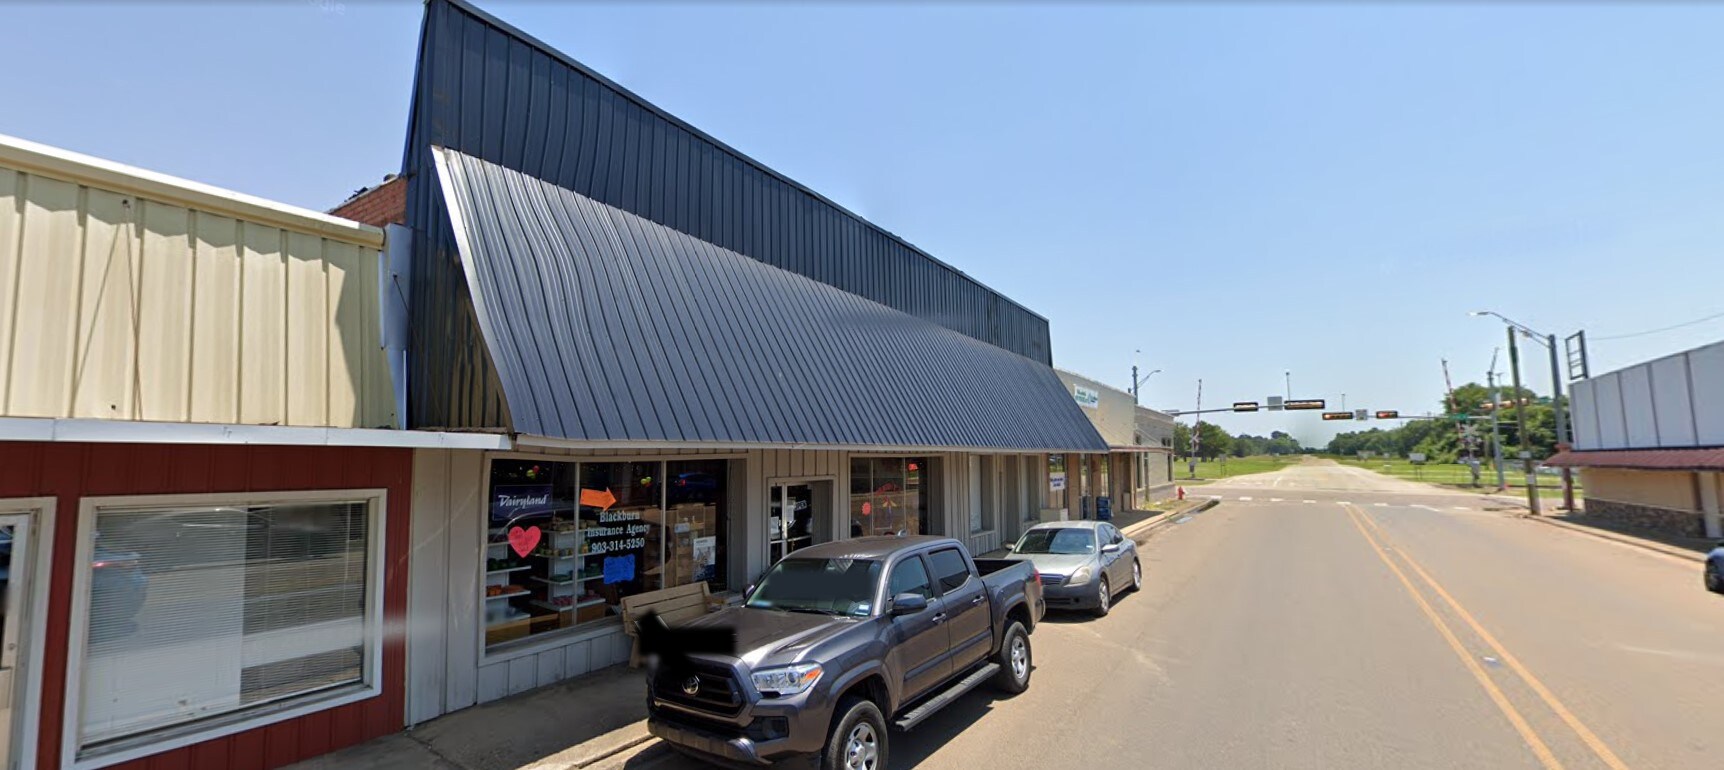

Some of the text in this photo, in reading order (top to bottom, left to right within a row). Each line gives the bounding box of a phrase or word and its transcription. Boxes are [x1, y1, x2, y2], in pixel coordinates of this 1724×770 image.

[498, 494, 549, 509] Dairyland
[600, 511, 640, 523] Blackburn
[587, 524, 650, 537] Insurance Agency
[591, 538, 645, 553] 903-314-5250
